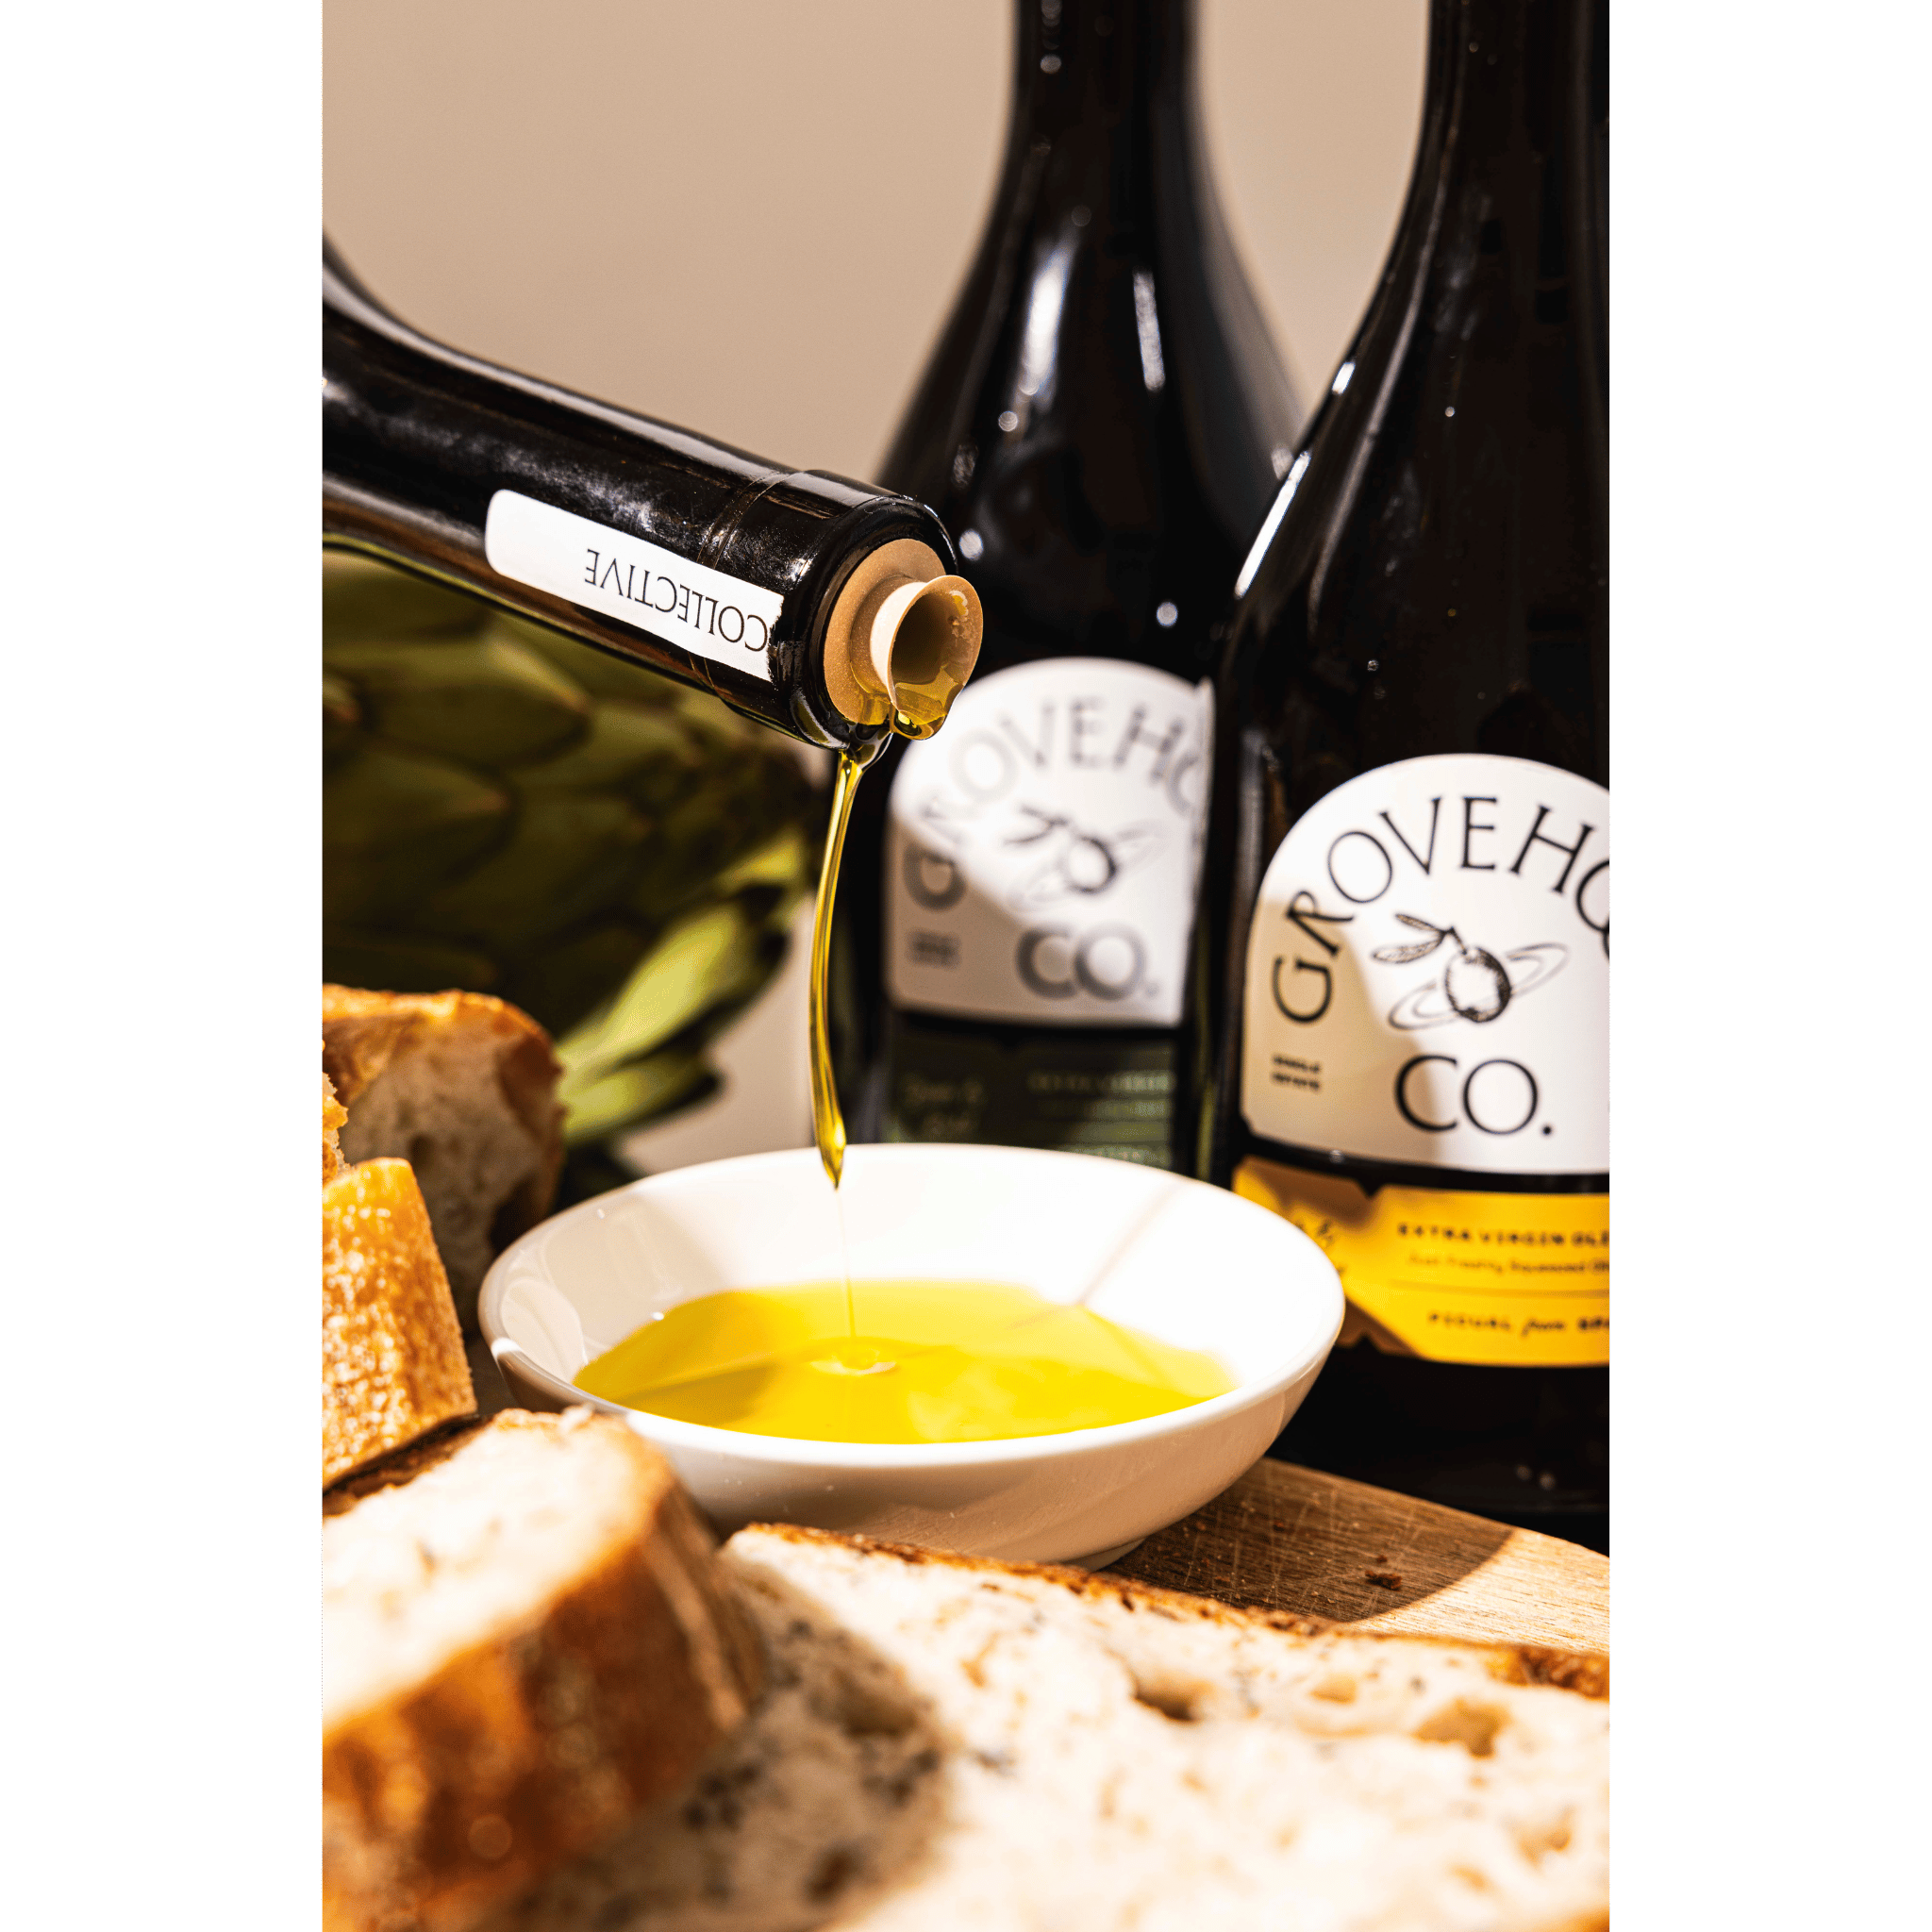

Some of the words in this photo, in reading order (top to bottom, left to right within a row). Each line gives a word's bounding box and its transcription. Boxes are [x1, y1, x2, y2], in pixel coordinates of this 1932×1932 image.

[584, 548, 769, 652] COLLECTIVE
[1271, 796, 1609, 1024] GROVEHO
[1015, 922, 1161, 1001] CO.
[1393, 1053, 1554, 1136] CO.
[1397, 1222, 1471, 1241] EXTRA
[1478, 1228, 1566, 1247] VIRGIN
